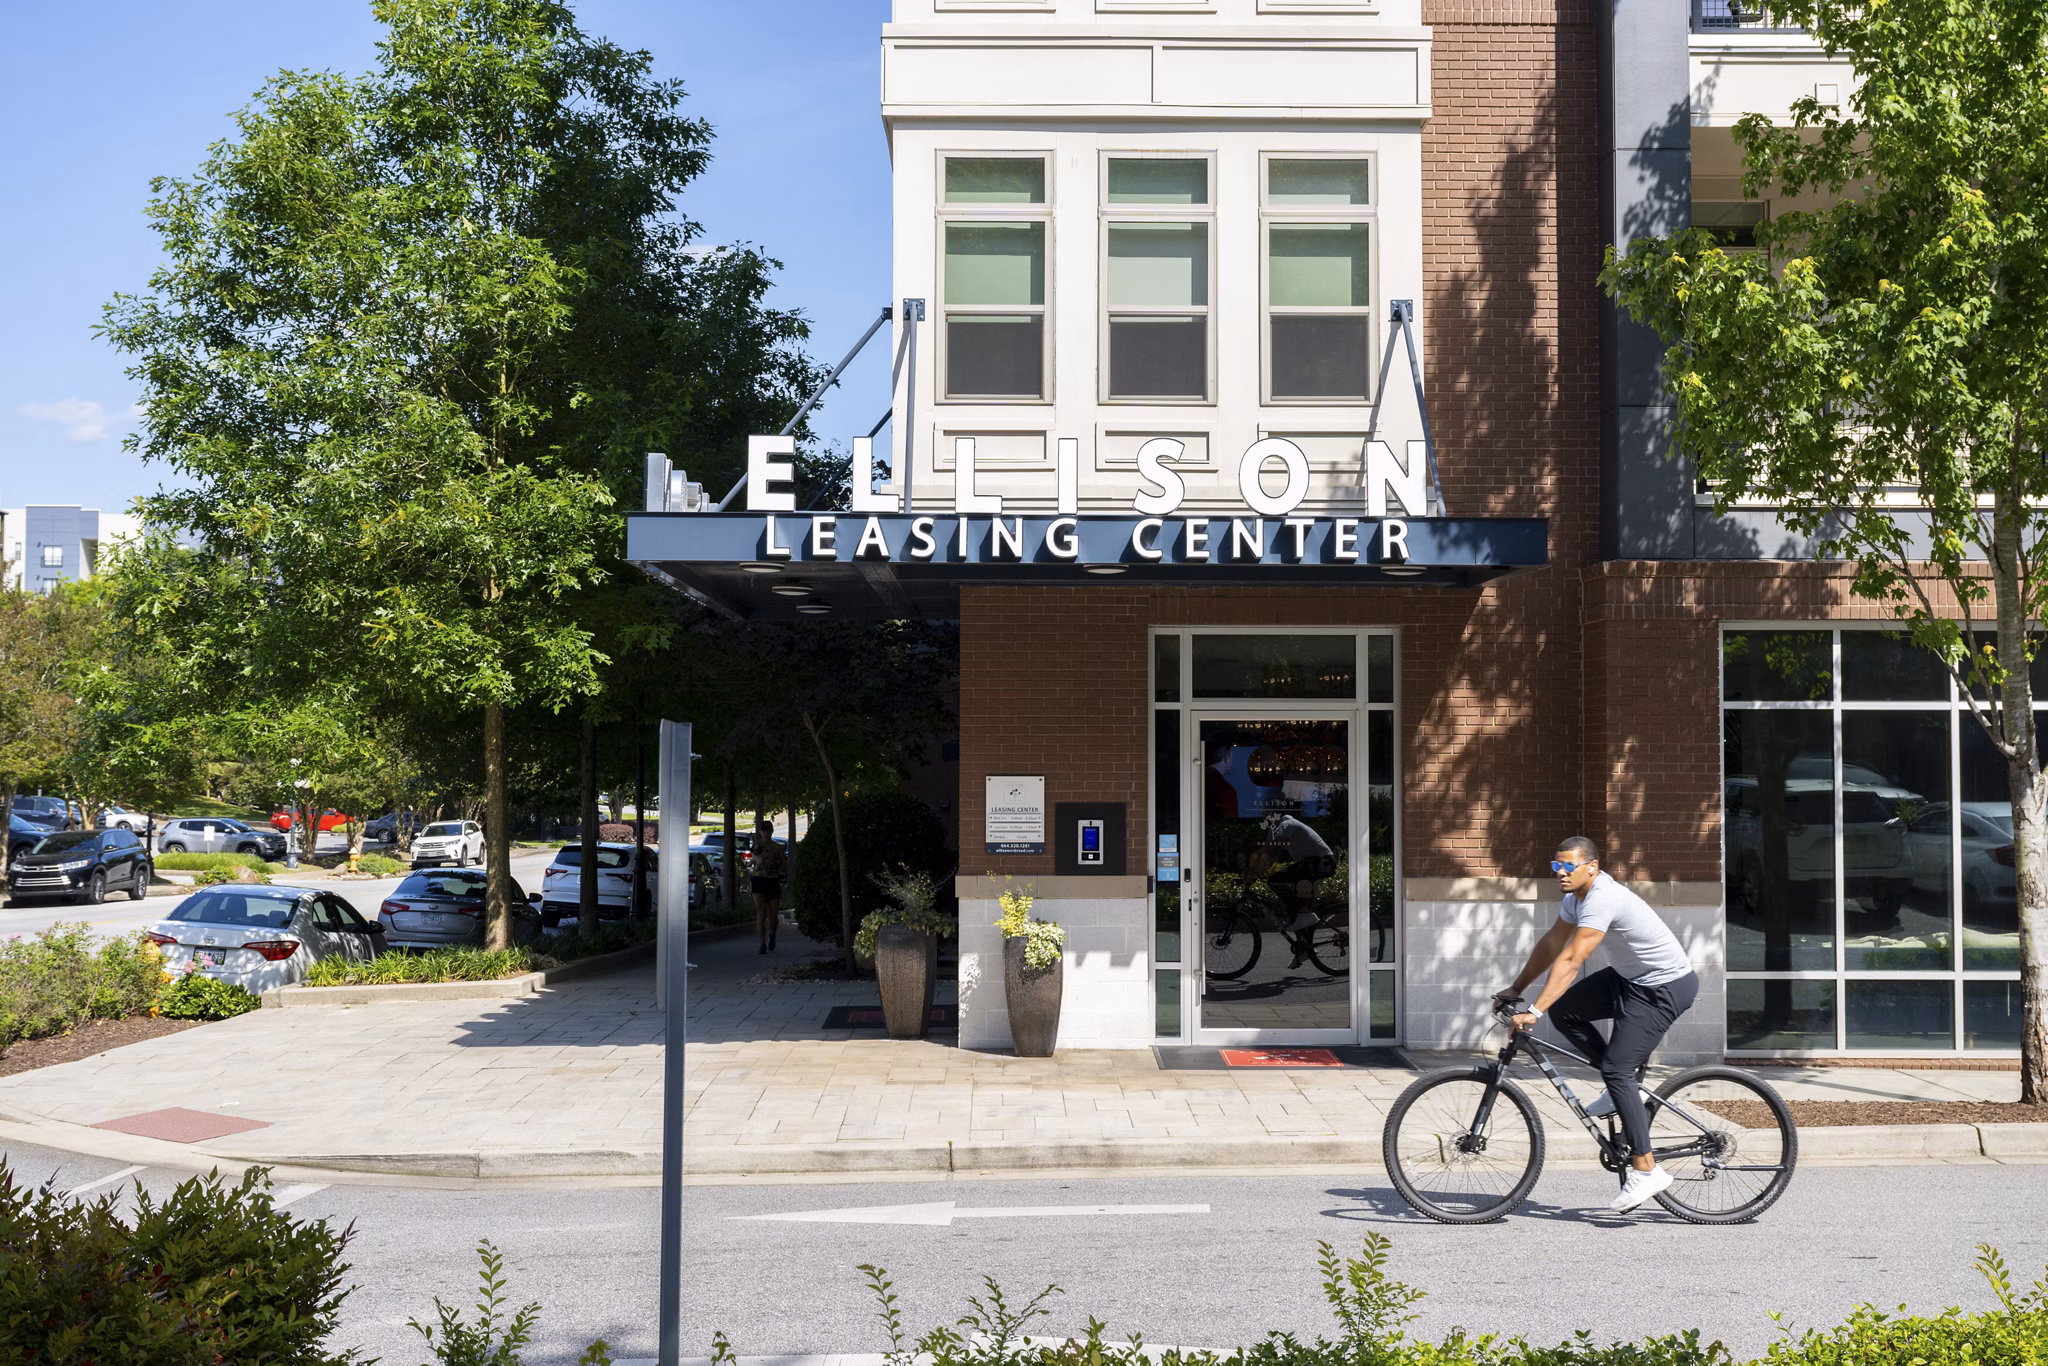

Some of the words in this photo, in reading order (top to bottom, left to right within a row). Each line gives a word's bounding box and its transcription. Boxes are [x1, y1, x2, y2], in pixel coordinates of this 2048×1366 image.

[747, 435, 1427, 516] ELLISON
[766, 515, 1080, 560] LEASING
[1131, 517, 1410, 560] CENTER
[1539, 1053, 1608, 1142] TREK
